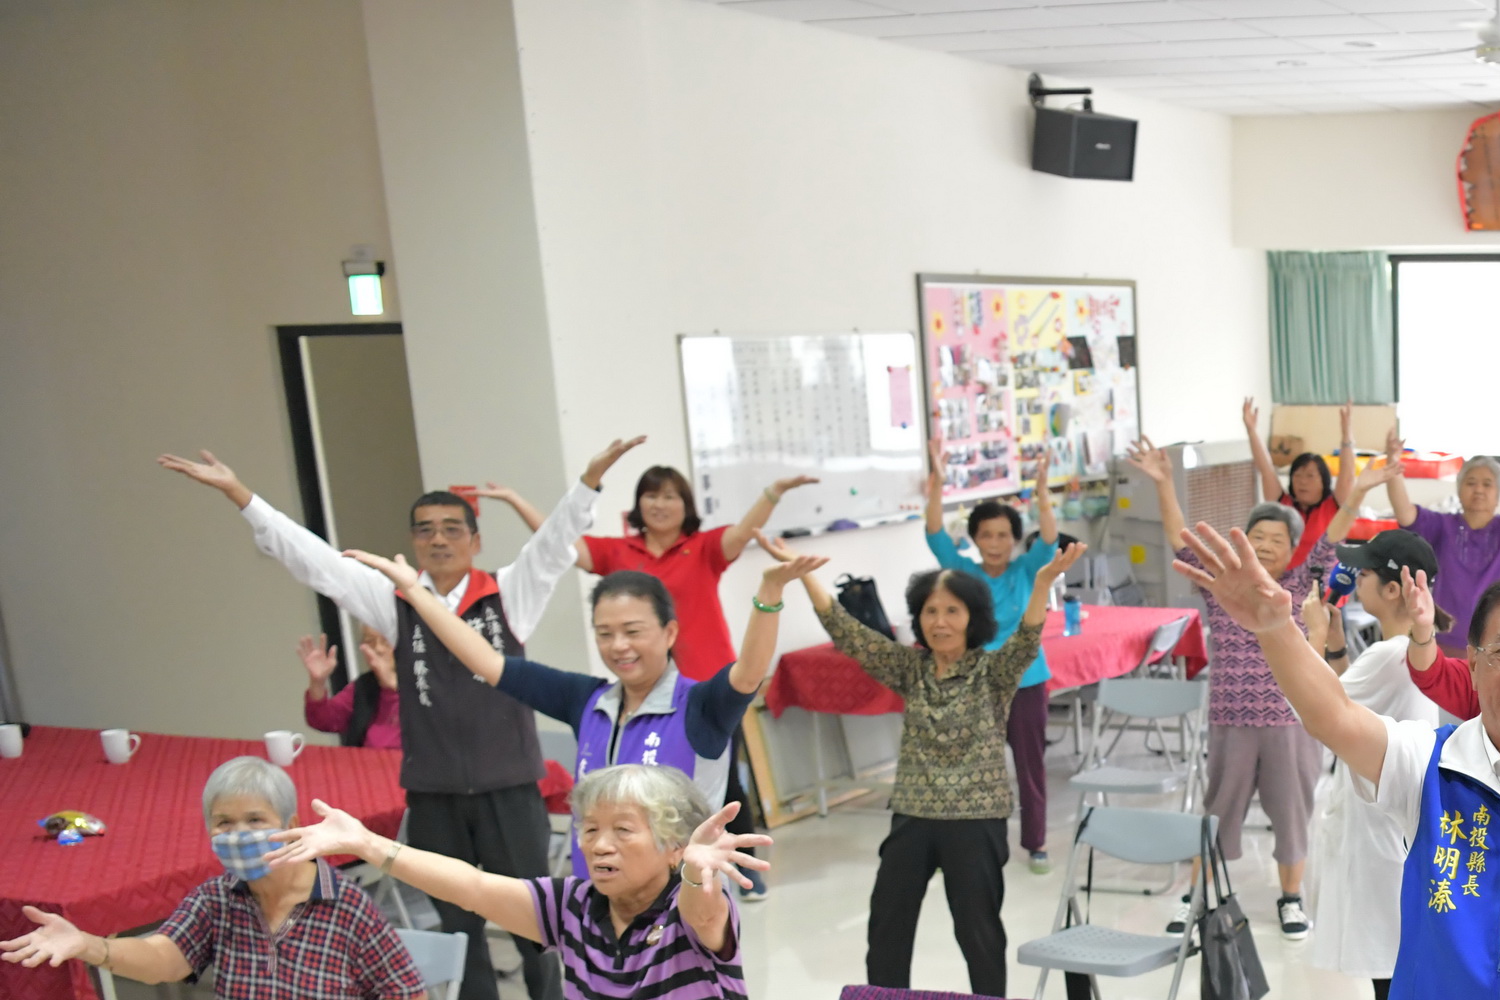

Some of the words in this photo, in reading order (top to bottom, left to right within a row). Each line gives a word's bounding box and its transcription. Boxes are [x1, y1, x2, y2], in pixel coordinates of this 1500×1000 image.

[1428, 809, 1468, 913] 林明溱
[1461, 803, 1491, 897] 南投縣長
